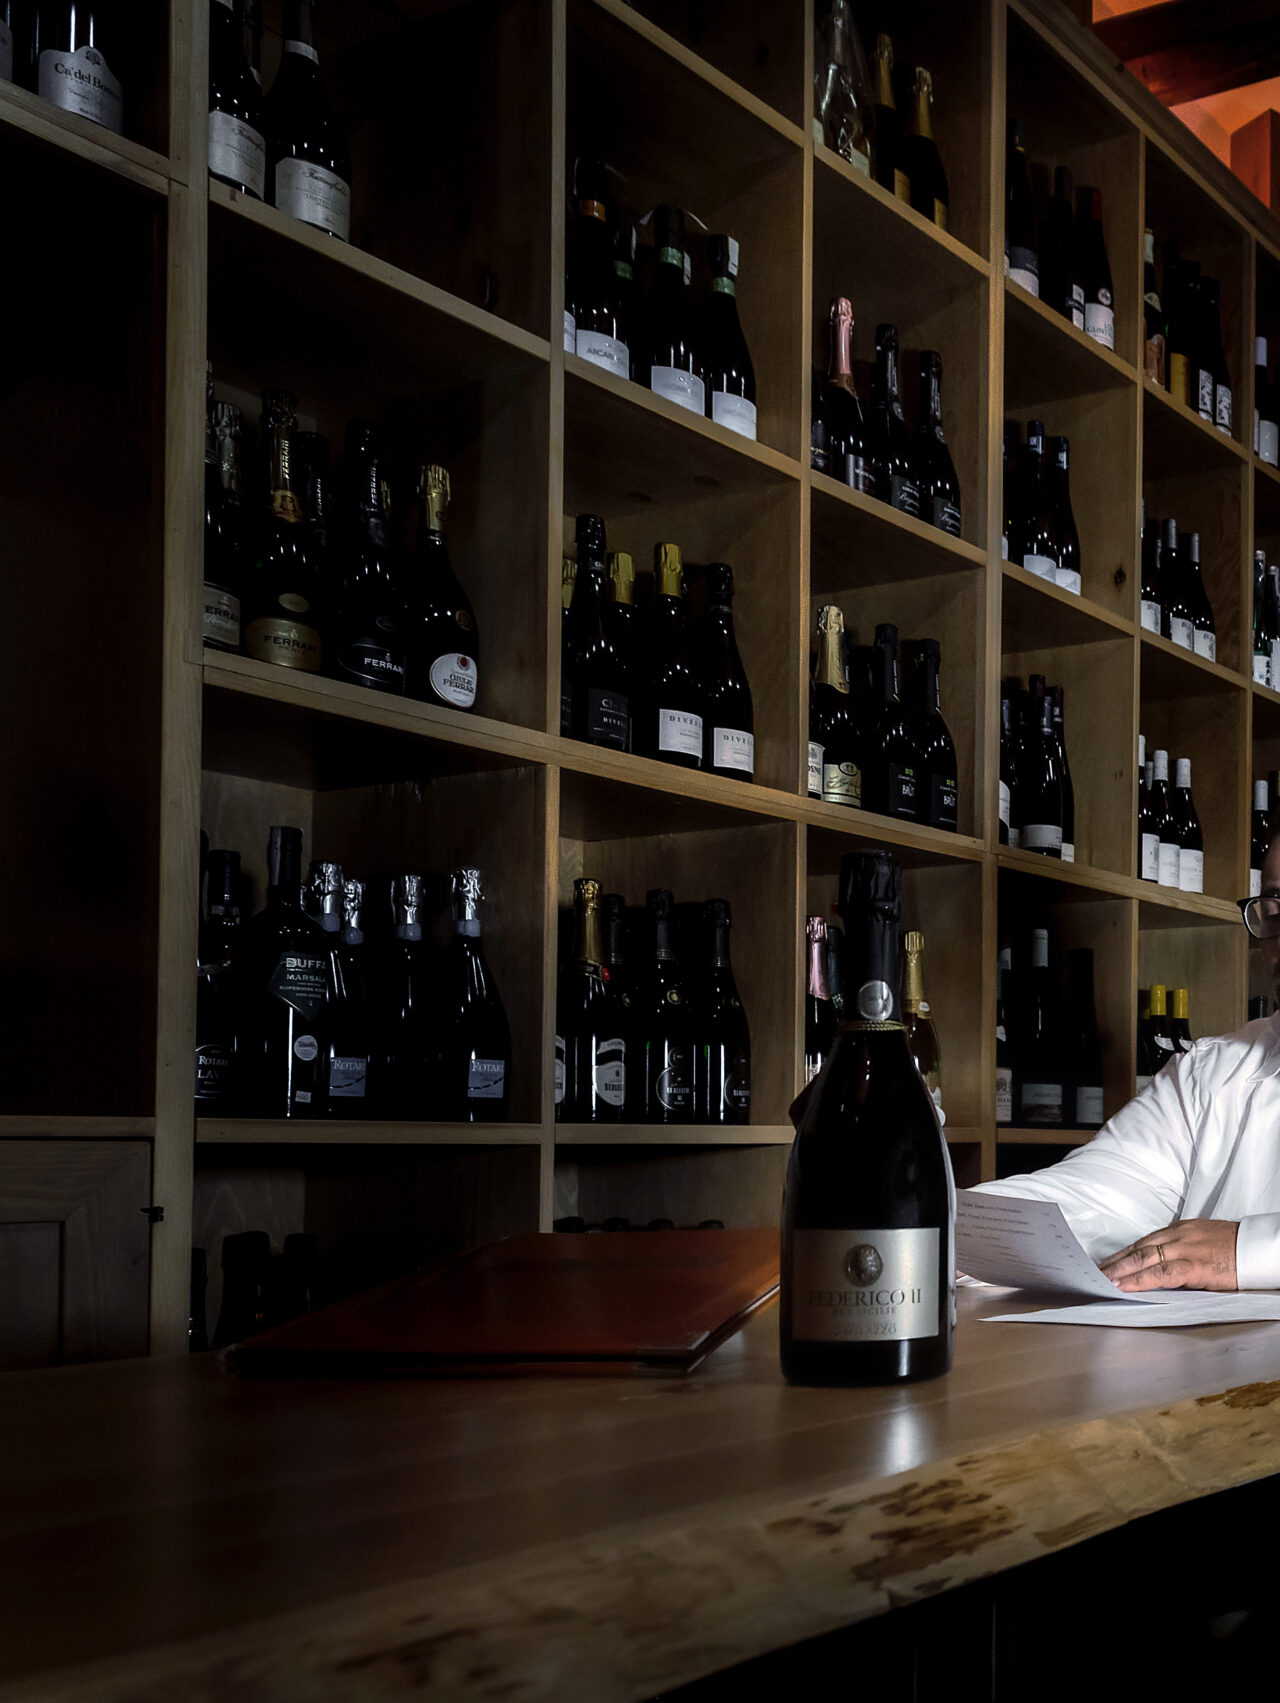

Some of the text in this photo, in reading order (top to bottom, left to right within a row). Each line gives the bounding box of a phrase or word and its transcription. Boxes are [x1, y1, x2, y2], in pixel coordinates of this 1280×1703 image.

[205, 605, 239, 621] ERRA
[264, 635, 315, 651] FERRA
[364, 657, 404, 675] FERRAR
[443, 678, 475, 694] FERRAR
[669, 715, 702, 729] DIVEL
[722, 734, 753, 746] DIVEL
[333, 1060, 364, 1071] ROTAR
[808, 1288, 921, 1307] FEDERICO II
